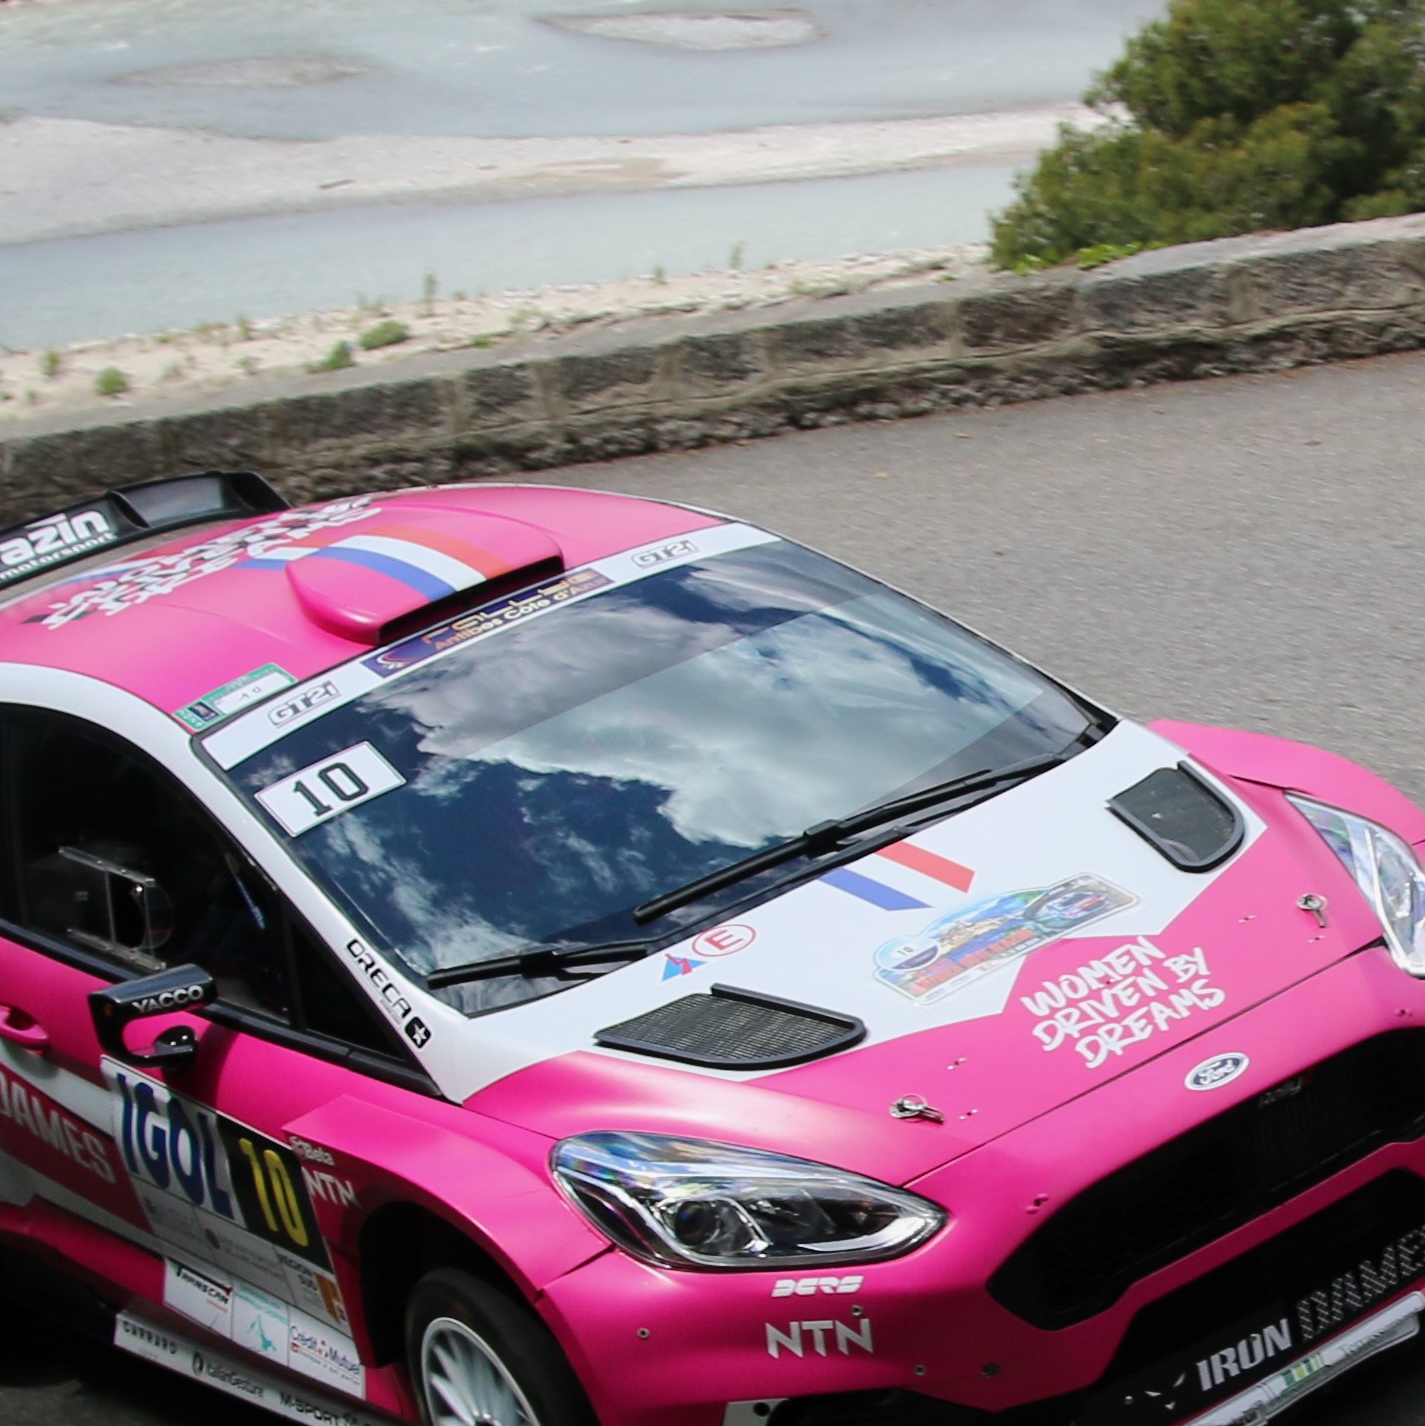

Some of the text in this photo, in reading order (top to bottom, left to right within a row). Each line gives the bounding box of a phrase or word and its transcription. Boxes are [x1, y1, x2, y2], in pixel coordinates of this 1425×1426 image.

[434, 616, 502, 651] Antibes
[292, 761, 369, 817] 10
[131, 984, 204, 1014] YACCO
[346, 937, 413, 1019] ORECA
[1020, 935, 1167, 1017] WOMEN
[1032, 967, 1170, 1052] DRIVEN
[1162, 946, 1211, 983] BY
[1075, 978, 1226, 1070] DREAMS
[116, 1072, 309, 1247] IGOL 10
[301, 1166, 359, 1208] NTN
[765, 1318, 874, 1360] NTN
[1196, 1318, 1292, 1392] IRON
